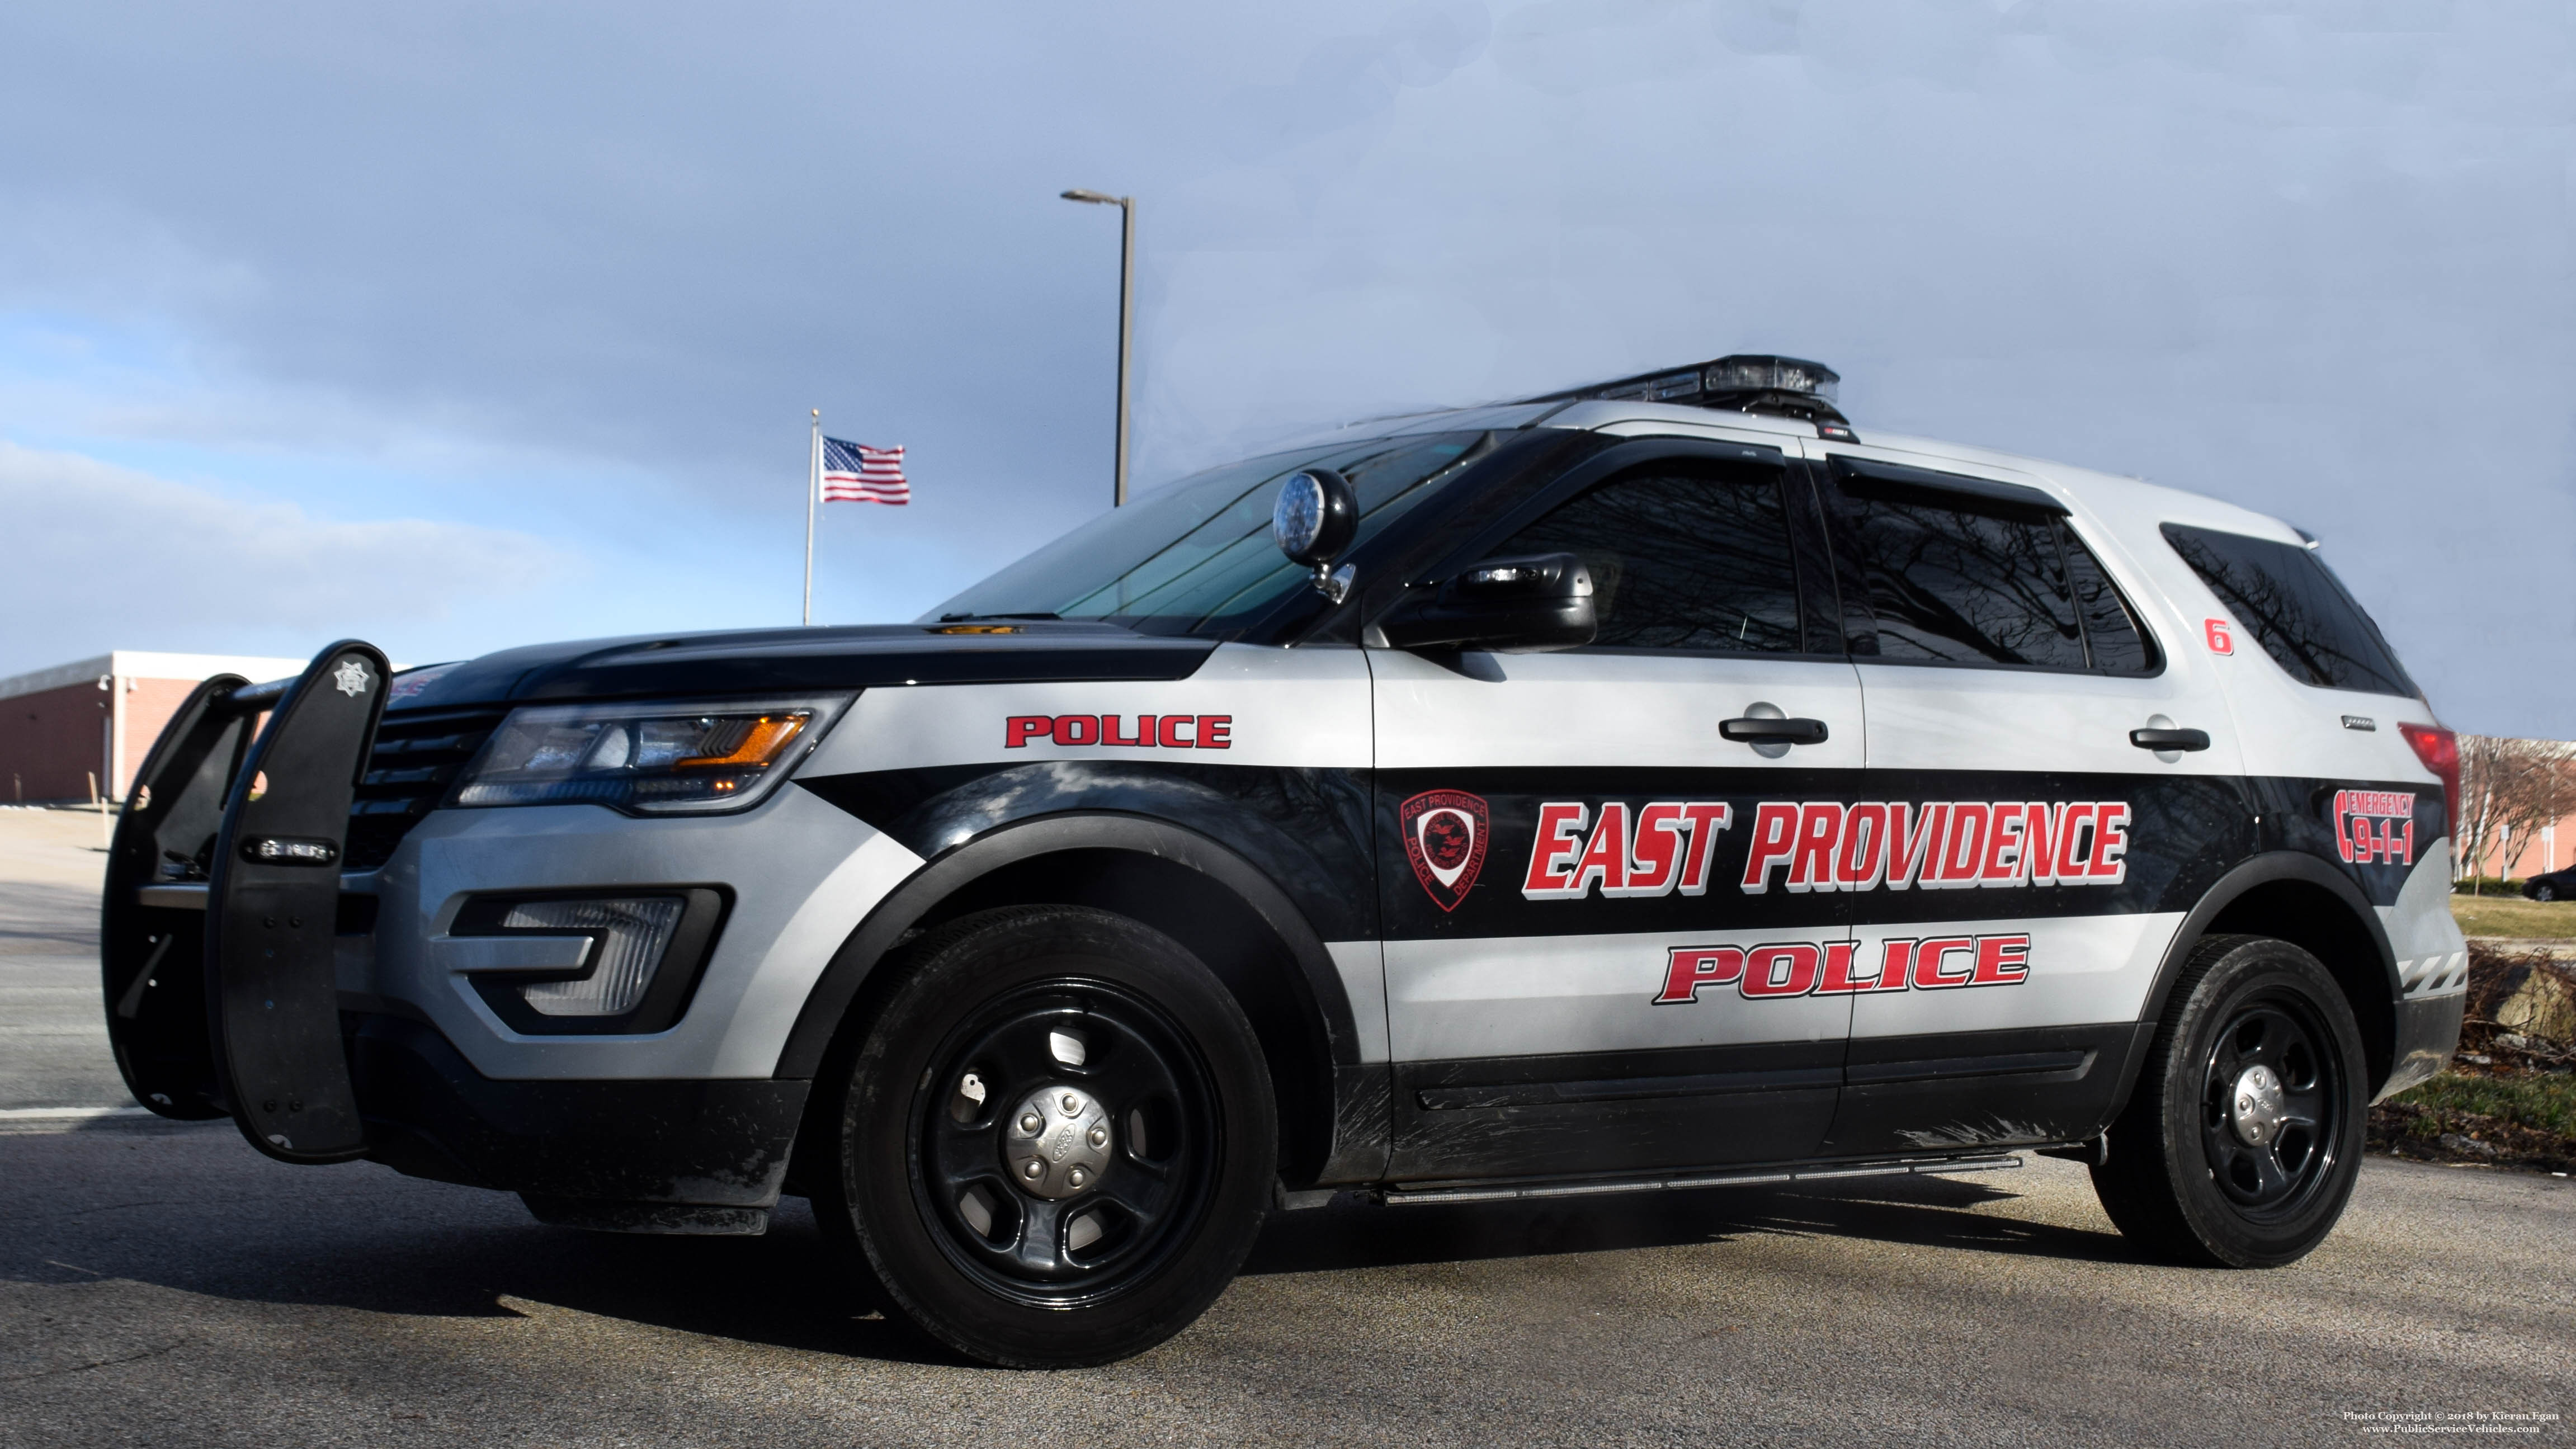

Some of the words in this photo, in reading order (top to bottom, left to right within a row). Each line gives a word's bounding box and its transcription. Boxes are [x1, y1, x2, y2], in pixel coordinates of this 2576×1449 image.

[2204, 617, 2234, 655] 6
[1004, 715, 1232, 749] POLICE
[1404, 799, 1426, 820] EAST
[1428, 794, 1485, 817] PROVIDENCE
[2348, 791, 2415, 817] EMERGENCY
[1408, 837, 1436, 885] POLICE
[1454, 820, 1486, 895] DEPARTMENT
[1521, 802, 1733, 900] EAST
[1740, 801, 2132, 894] PROVIDENCE
[2352, 817, 2413, 865] 9-1-1
[1651, 933, 2031, 1006] POLICE
